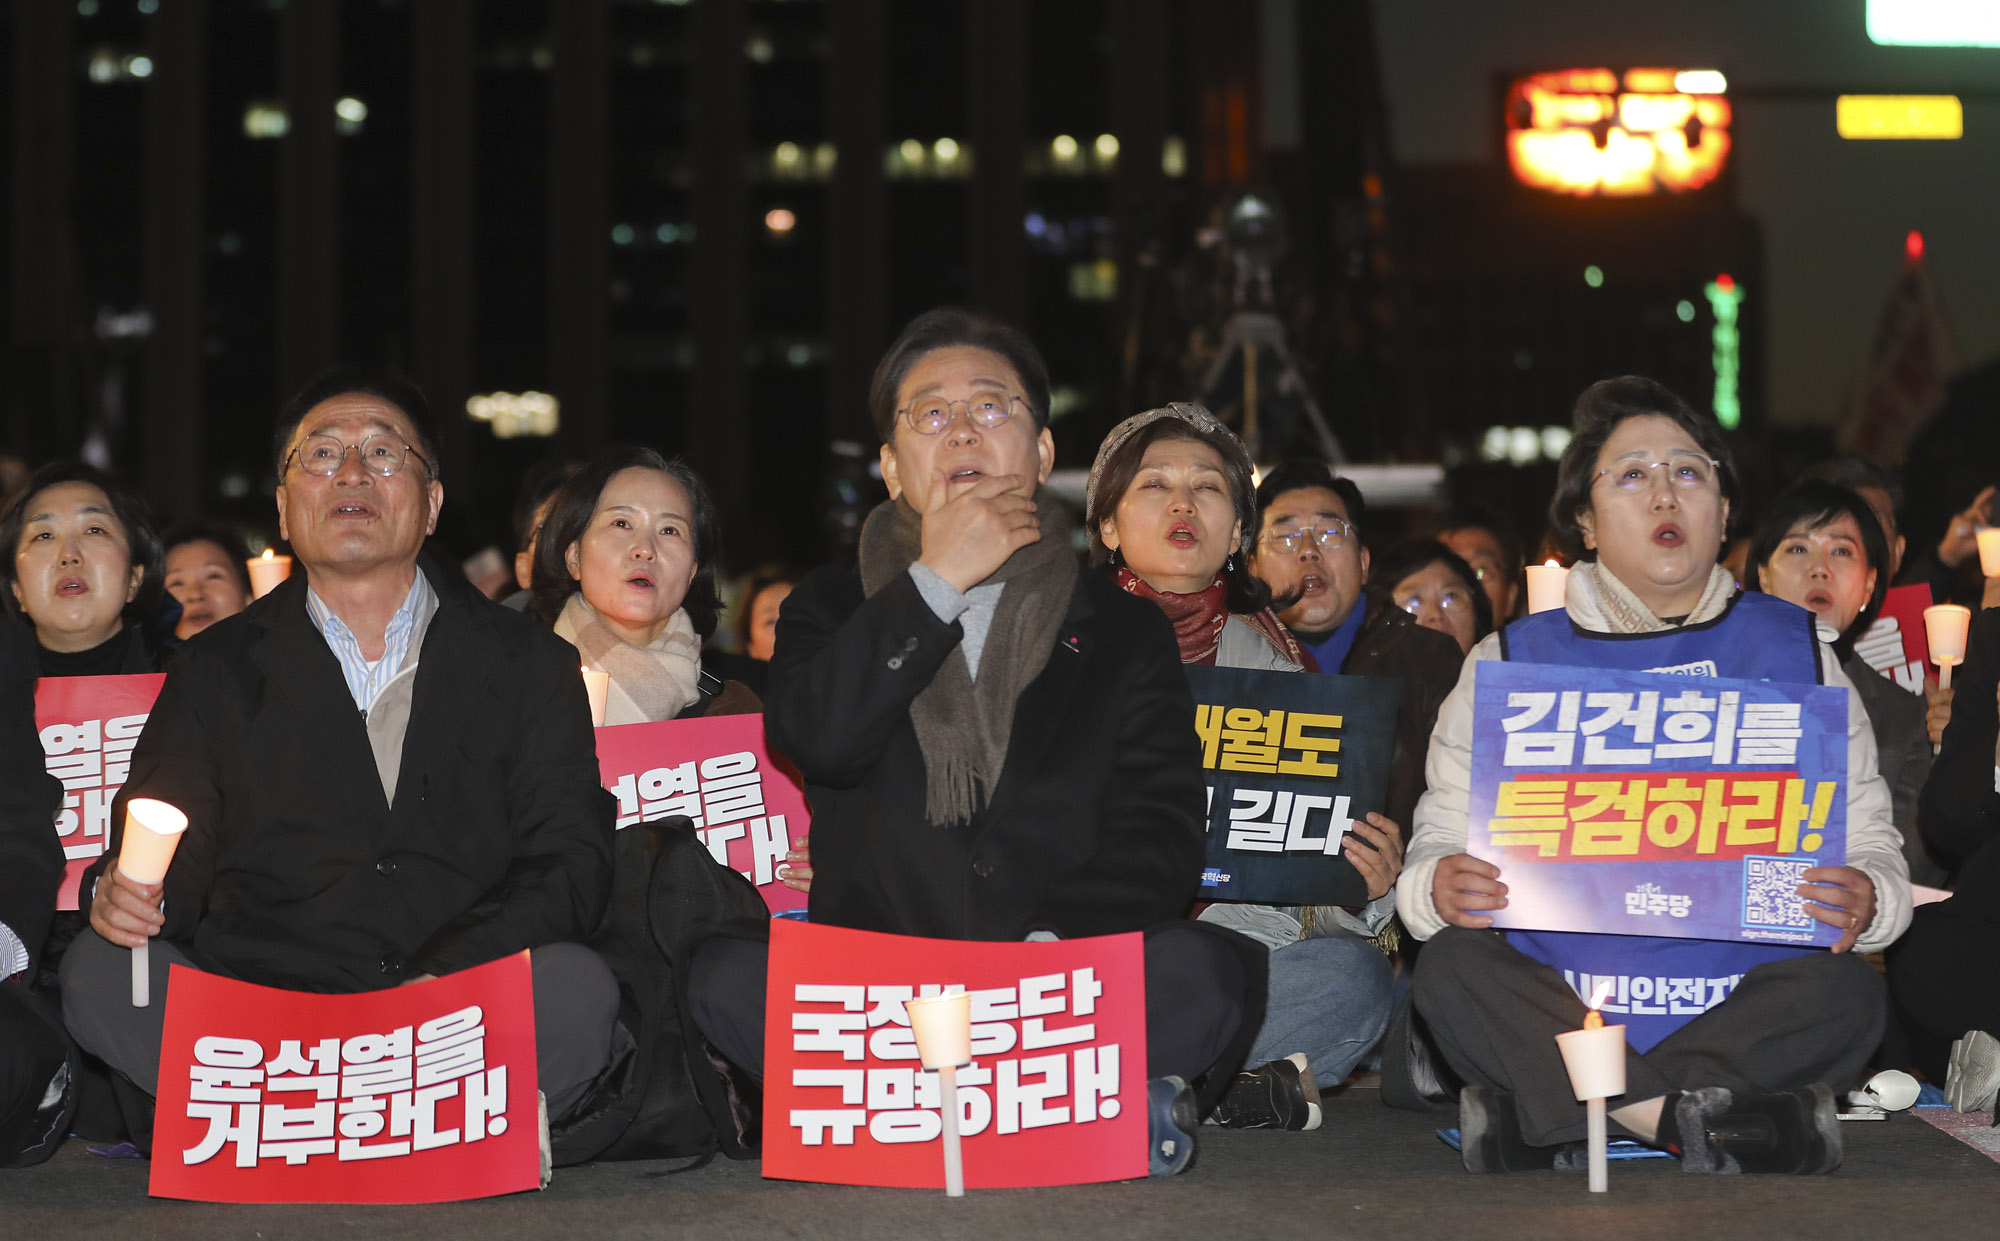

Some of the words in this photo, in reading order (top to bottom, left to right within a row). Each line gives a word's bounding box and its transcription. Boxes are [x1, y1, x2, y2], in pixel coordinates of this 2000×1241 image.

[1500, 691, 1803, 766] 김건희를
[1226, 788, 1354, 855] 길다
[1488, 778, 1837, 857] 특검하라!
[1201, 872, 1231, 882] 국혁신당
[1625, 892, 1692, 918] 민주당
[190, 1005, 485, 1102] 윤석열을
[183, 1065, 508, 1167] 거부한다!
[790, 1043, 1121, 1145] 규명하라!
